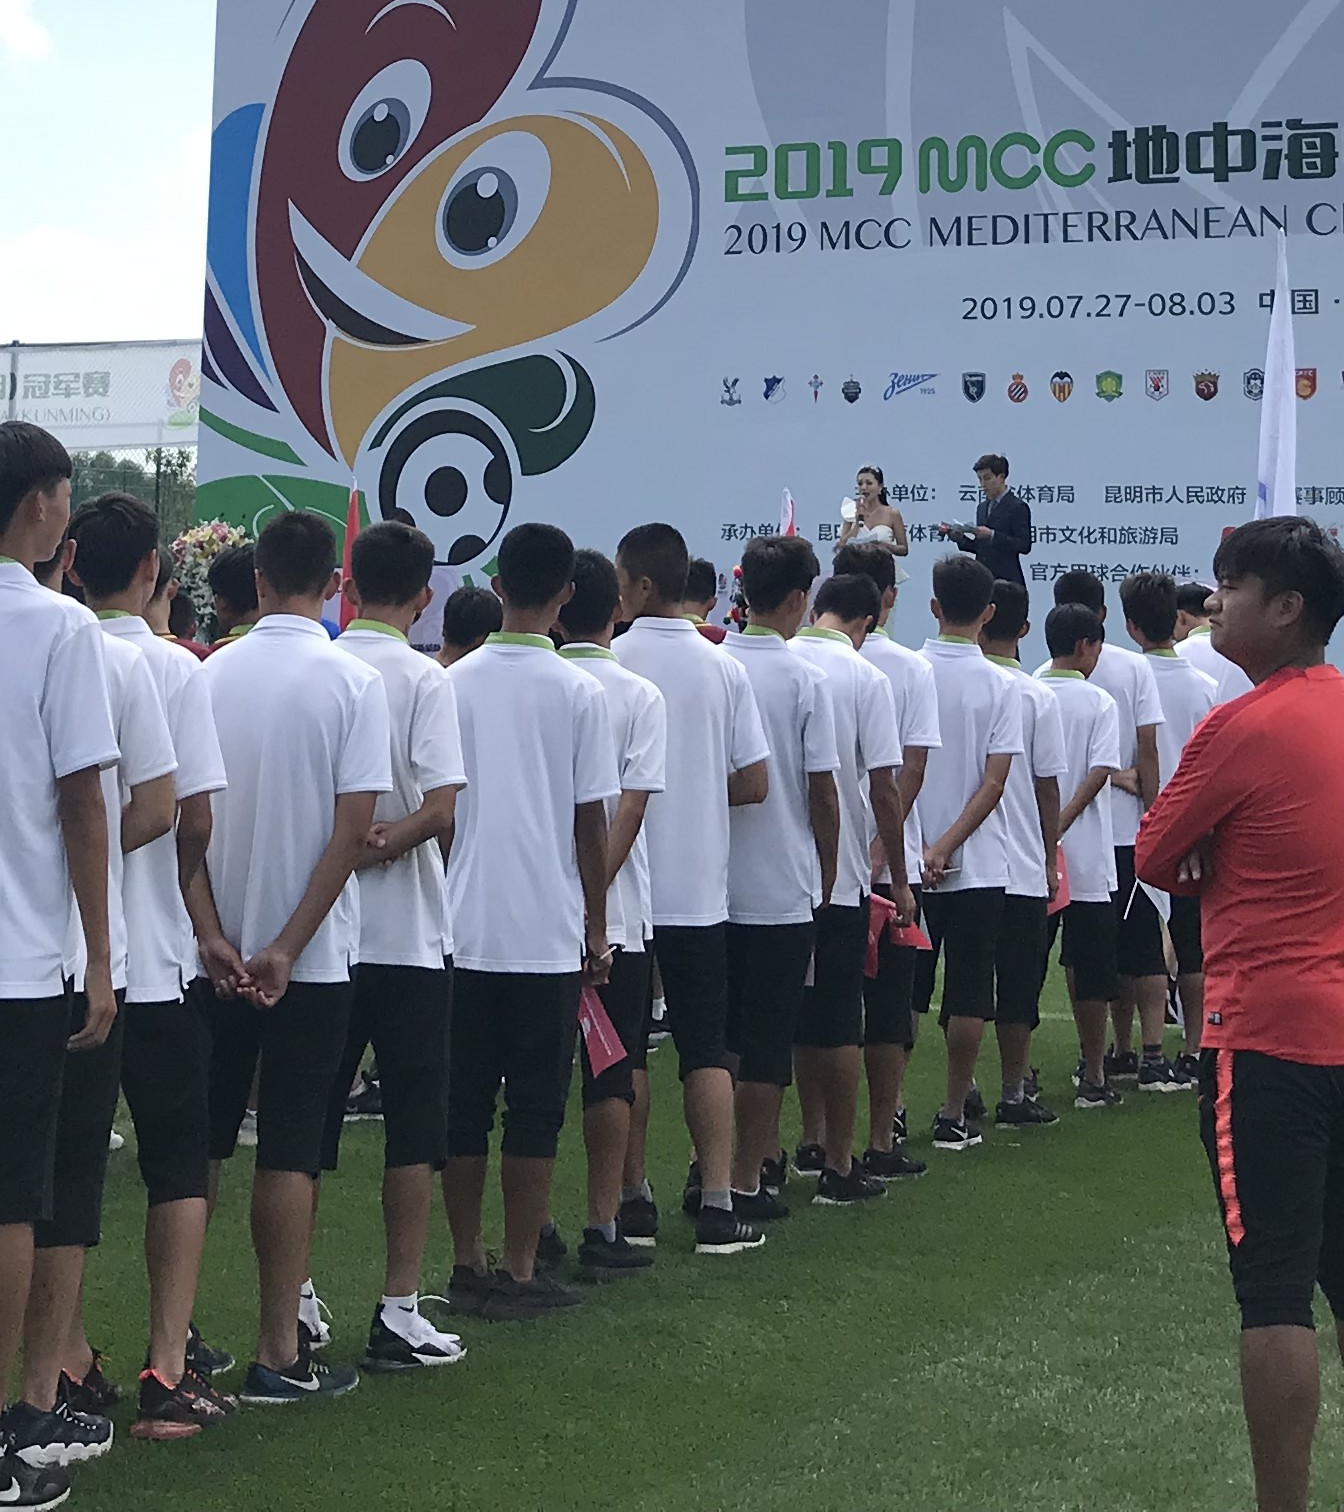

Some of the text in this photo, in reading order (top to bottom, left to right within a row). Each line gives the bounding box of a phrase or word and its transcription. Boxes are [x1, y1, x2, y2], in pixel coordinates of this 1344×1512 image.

[723, 137, 904, 202] 2019
[918, 128, 1096, 194] MCC
[723, 223, 807, 255] 2019
[820, 217, 912, 252] MCC
[928, 204, 1288, 247] MEDITERRANEAN
[961, 291, 1236, 321] 2019.07.27-08.03
[1104, 485, 1247, 505] 昆明市人民政府
[1030, 525, 1179, 546] 市文化和旅游局
